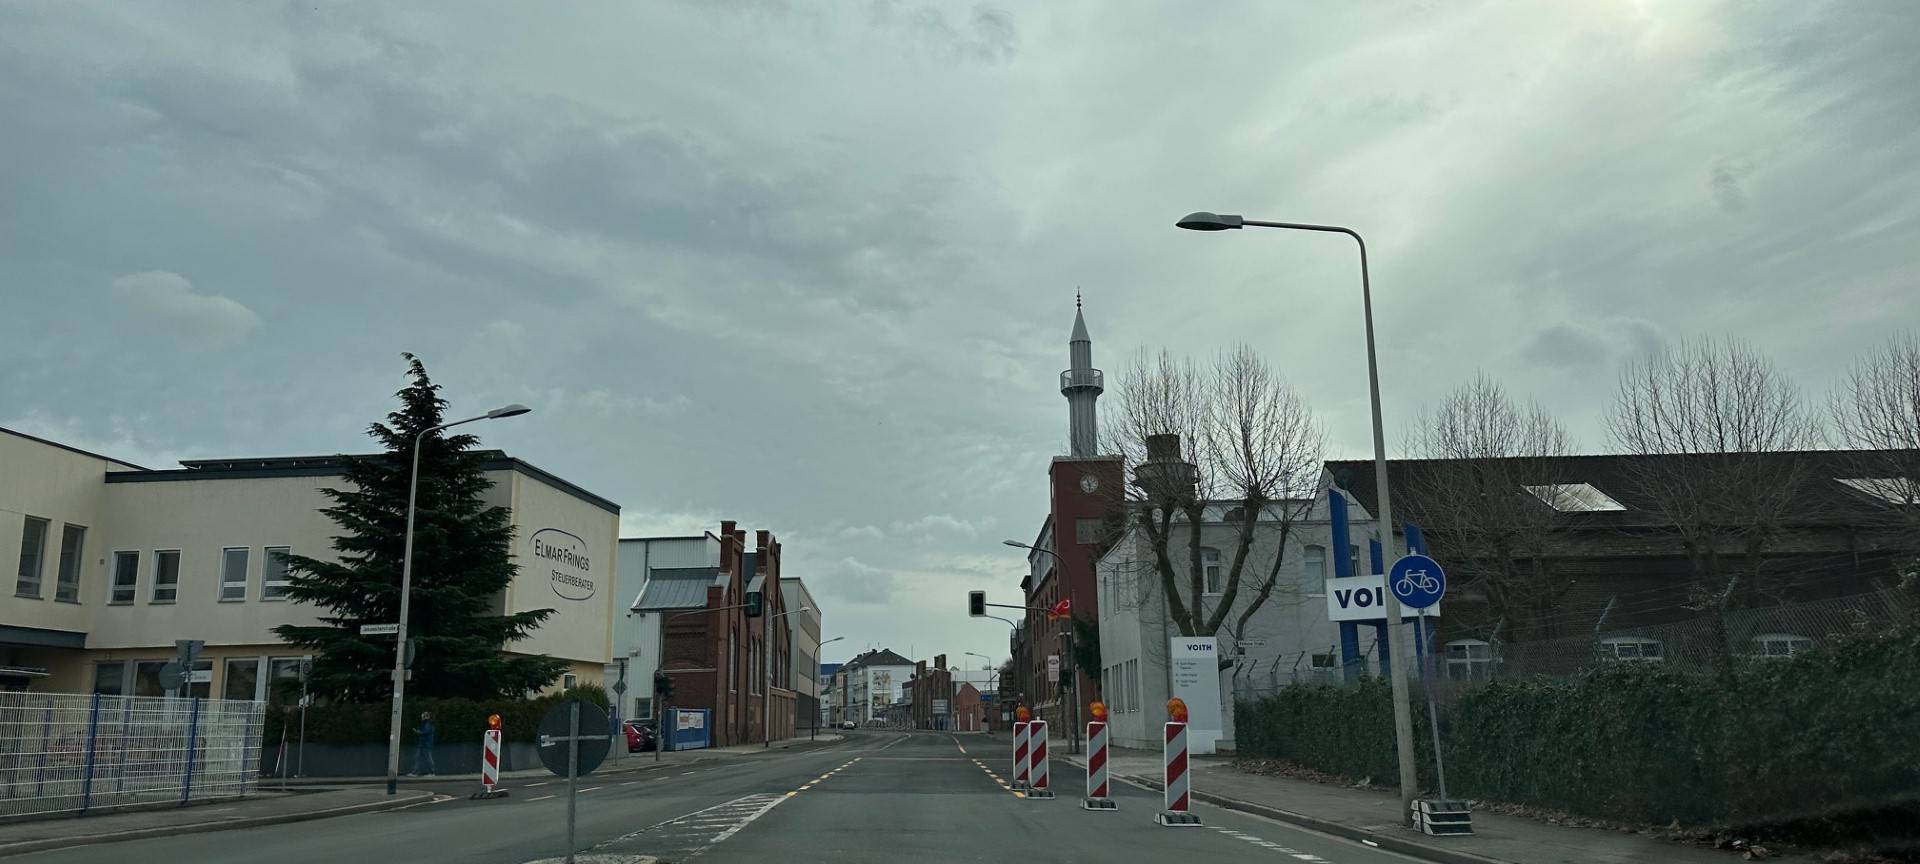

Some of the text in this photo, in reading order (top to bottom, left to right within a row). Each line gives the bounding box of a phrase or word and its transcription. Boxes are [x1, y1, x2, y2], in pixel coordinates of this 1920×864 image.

[535, 539, 563, 562] ELMAR
[551, 569, 594, 591] STEUERBERATER
[1334, 586, 1384, 609] VOI
